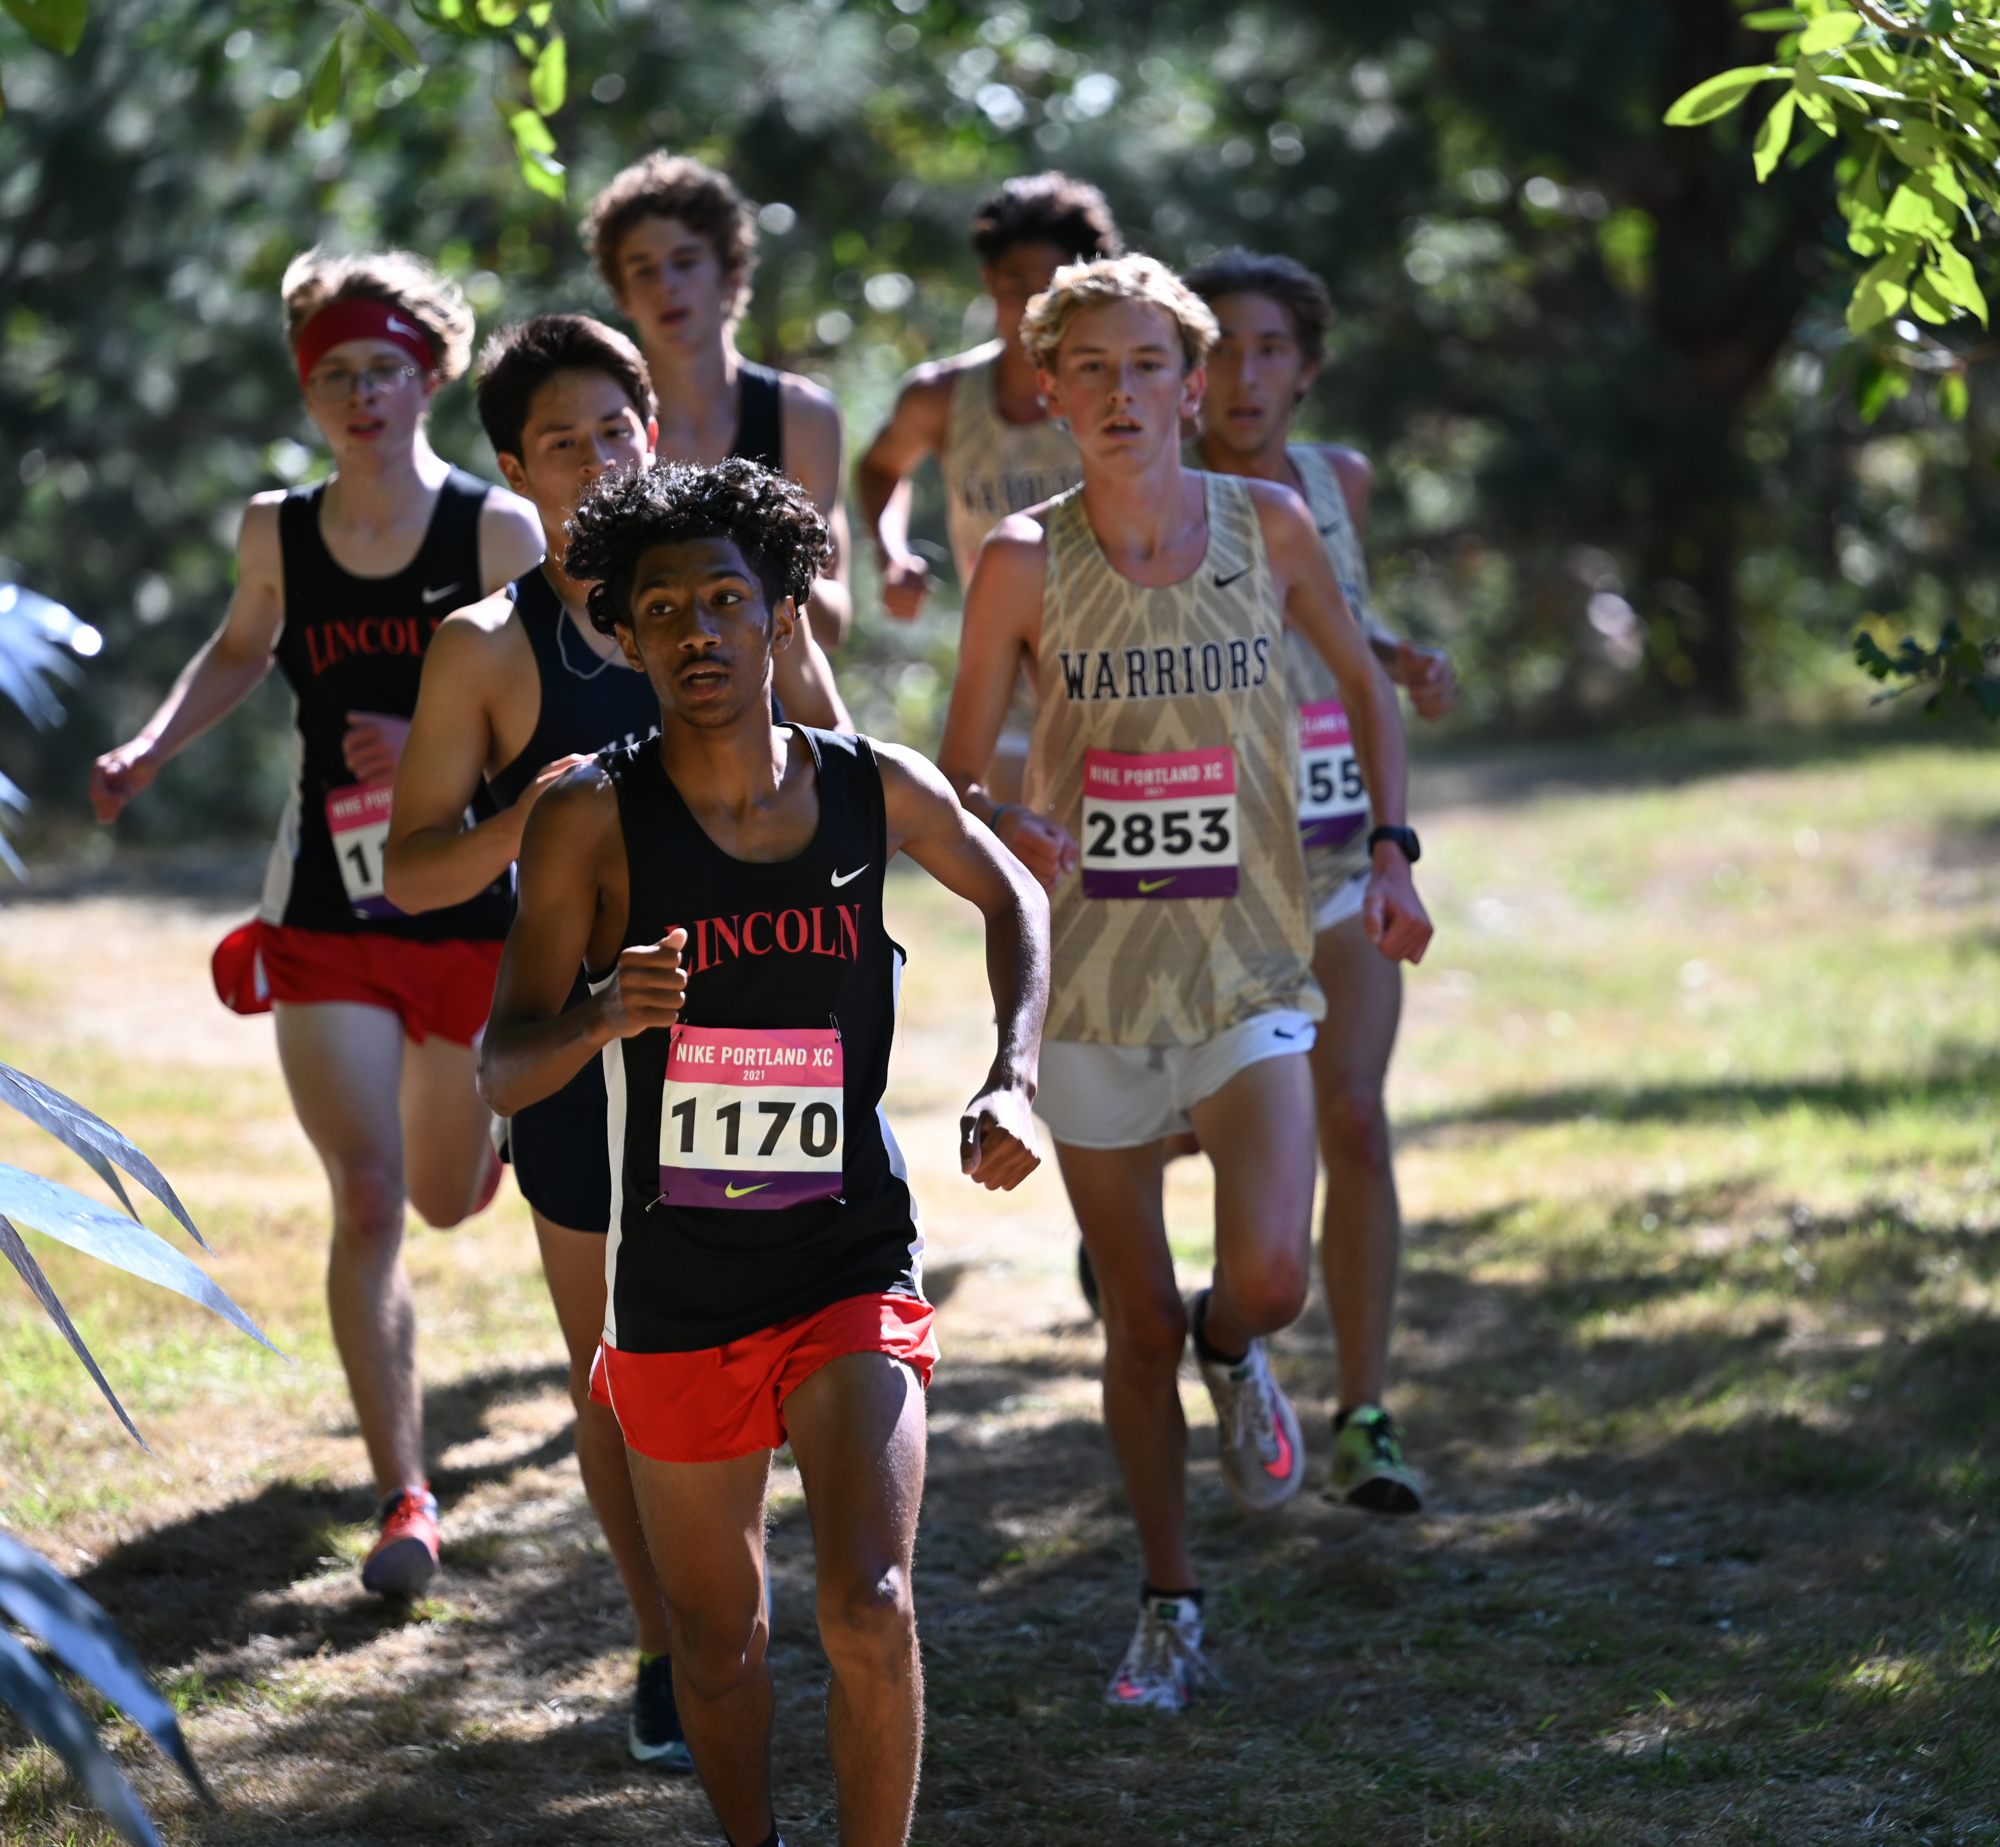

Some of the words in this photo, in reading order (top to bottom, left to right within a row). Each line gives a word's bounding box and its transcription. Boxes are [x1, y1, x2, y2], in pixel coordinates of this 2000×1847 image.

[306, 616, 441, 675] LINCOL
[1058, 635, 1268, 700] WARRIORS
[1089, 764, 1121, 786] NIKE
[1124, 764, 1200, 786] PORTLAND
[1203, 761, 1224, 782] XC
[1297, 758, 1362, 803] 55
[333, 795, 361, 818] NIKE
[1086, 808, 1231, 857] 2853
[346, 839, 387, 884] 1
[664, 904, 861, 977] INCOLN
[676, 1043, 715, 1063] NIKE
[720, 1046, 807, 1067] PORTLAND
[812, 1047, 833, 1067] XC
[742, 1069, 765, 1081] 2021
[671, 1096, 838, 1158] 1170
